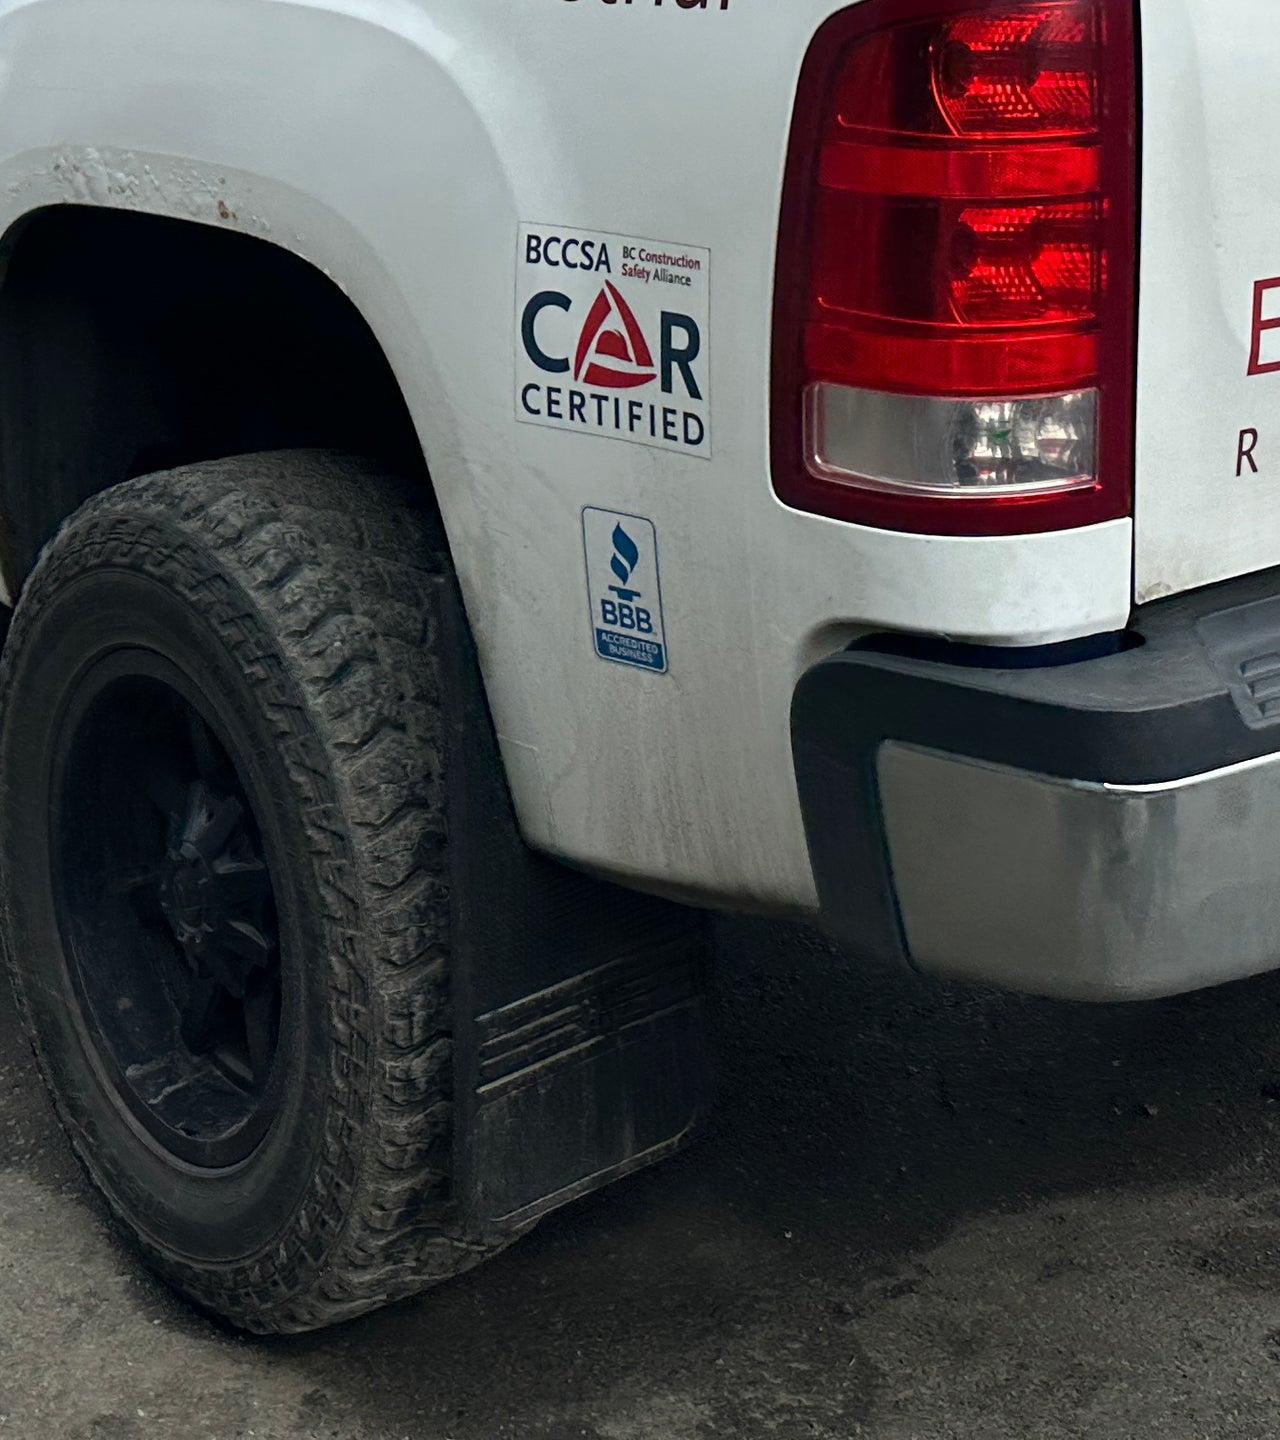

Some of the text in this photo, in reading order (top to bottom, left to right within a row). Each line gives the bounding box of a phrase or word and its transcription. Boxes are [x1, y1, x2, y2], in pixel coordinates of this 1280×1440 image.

[525, 234, 612, 273] BCCSA
[622, 246, 700, 270] BC Construction
[621, 263, 691, 286] Safety Alliance
[521, 383, 705, 446] CERTIFIED
[600, 598, 653, 634] BBB
[601, 632, 658, 655] ACCREDITED
[609, 644, 653, 663] BUSINESS
